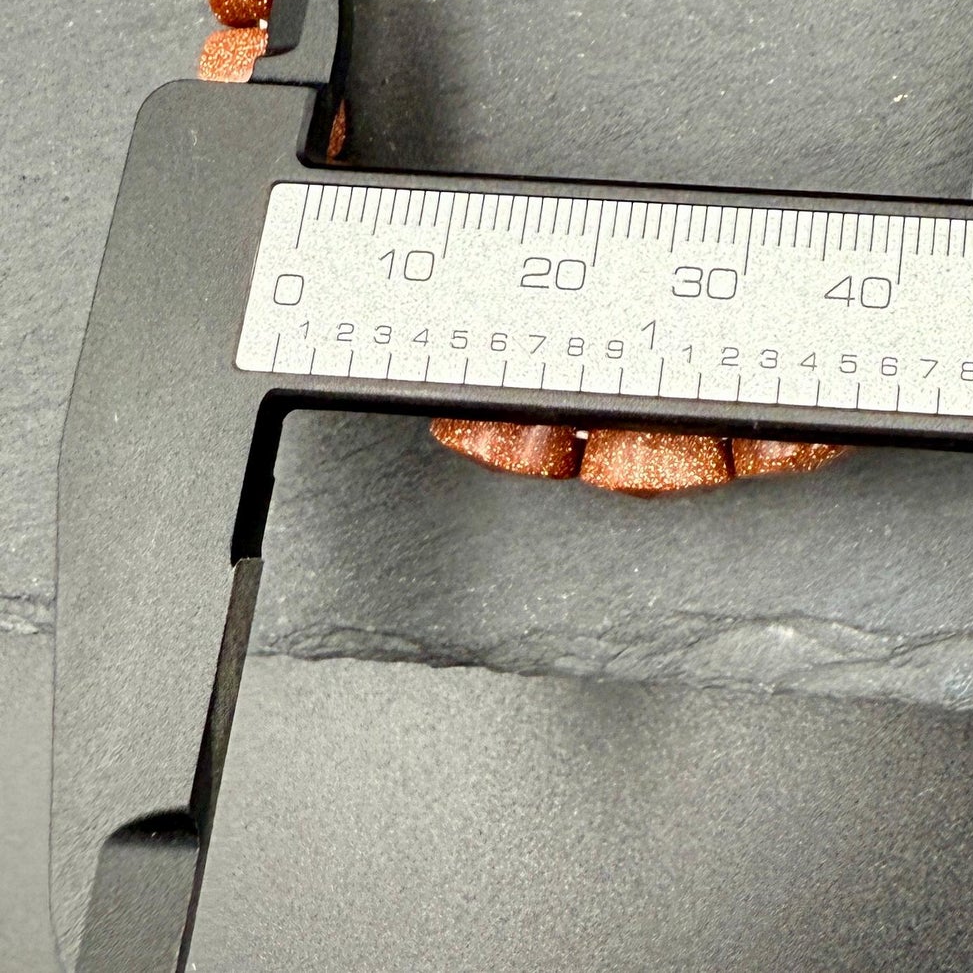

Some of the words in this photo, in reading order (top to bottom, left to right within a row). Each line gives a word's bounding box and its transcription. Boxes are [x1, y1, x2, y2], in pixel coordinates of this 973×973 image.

[273, 273, 305, 306] 0
[378, 248, 435, 282] 10
[519, 257, 587, 291] 20
[671, 265, 739, 300] 30
[823, 275, 892, 309] 40
[299, 320, 311, 339] 1
[336, 322, 355, 342] 2
[373, 325, 392, 345] 3
[412, 328, 430, 348] 4
[450, 330, 469, 350] 5
[490, 332, 509, 352] 6
[528, 334, 547, 355] 7
[566, 337, 585, 357] 8
[605, 339, 625, 360] 9
[640, 319, 658, 351] 1
[681, 344, 693, 364] 1
[721, 346, 740, 367] 2
[759, 349, 779, 370] 3
[799, 352, 818, 372] 4
[839, 354, 858, 374] 5
[880, 357, 899, 377] 6
[919, 358, 939, 379] 7
